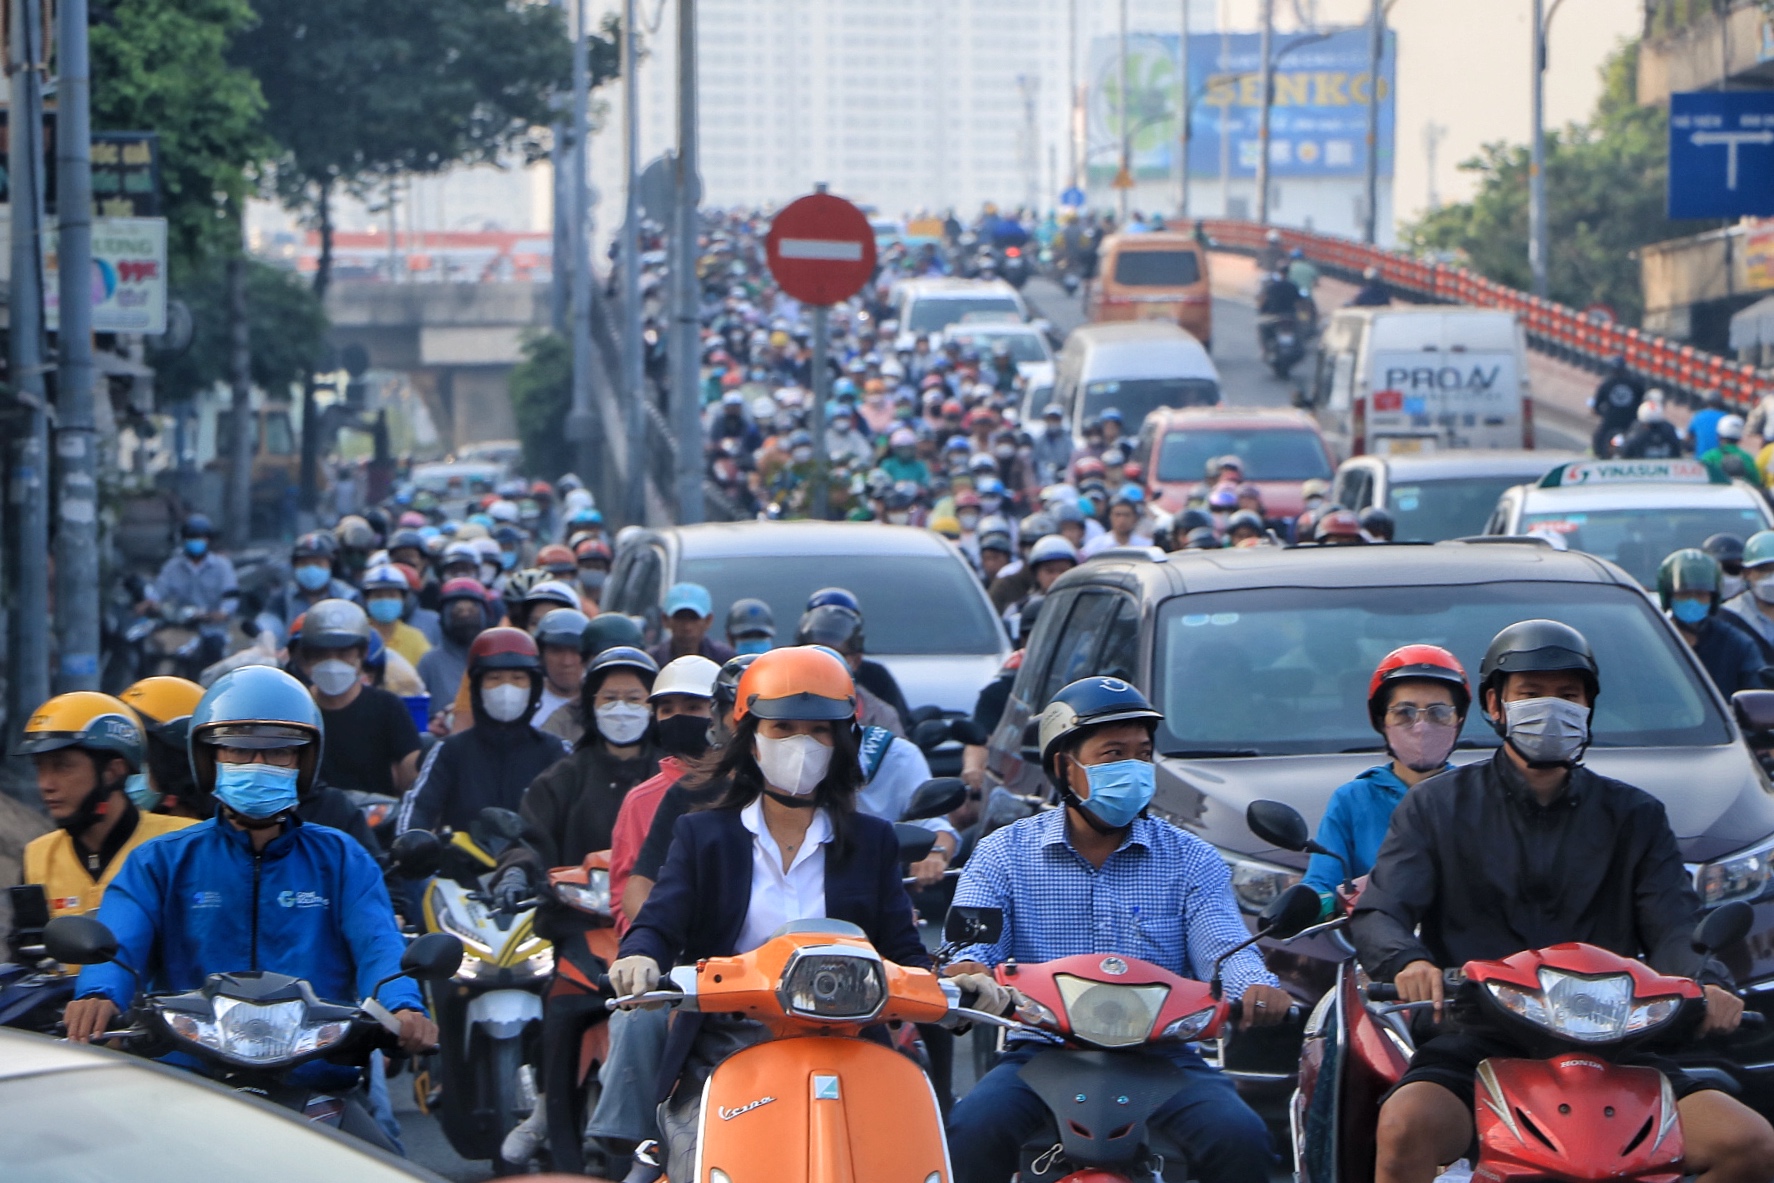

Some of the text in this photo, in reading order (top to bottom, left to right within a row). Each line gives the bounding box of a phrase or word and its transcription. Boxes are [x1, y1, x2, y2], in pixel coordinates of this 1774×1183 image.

[1206, 71, 1389, 106] SENKO
[1597, 464, 1669, 477] VINASUN
[1560, 1059, 1605, 1071] HONDA
[718, 1095, 777, 1121] Vespa
